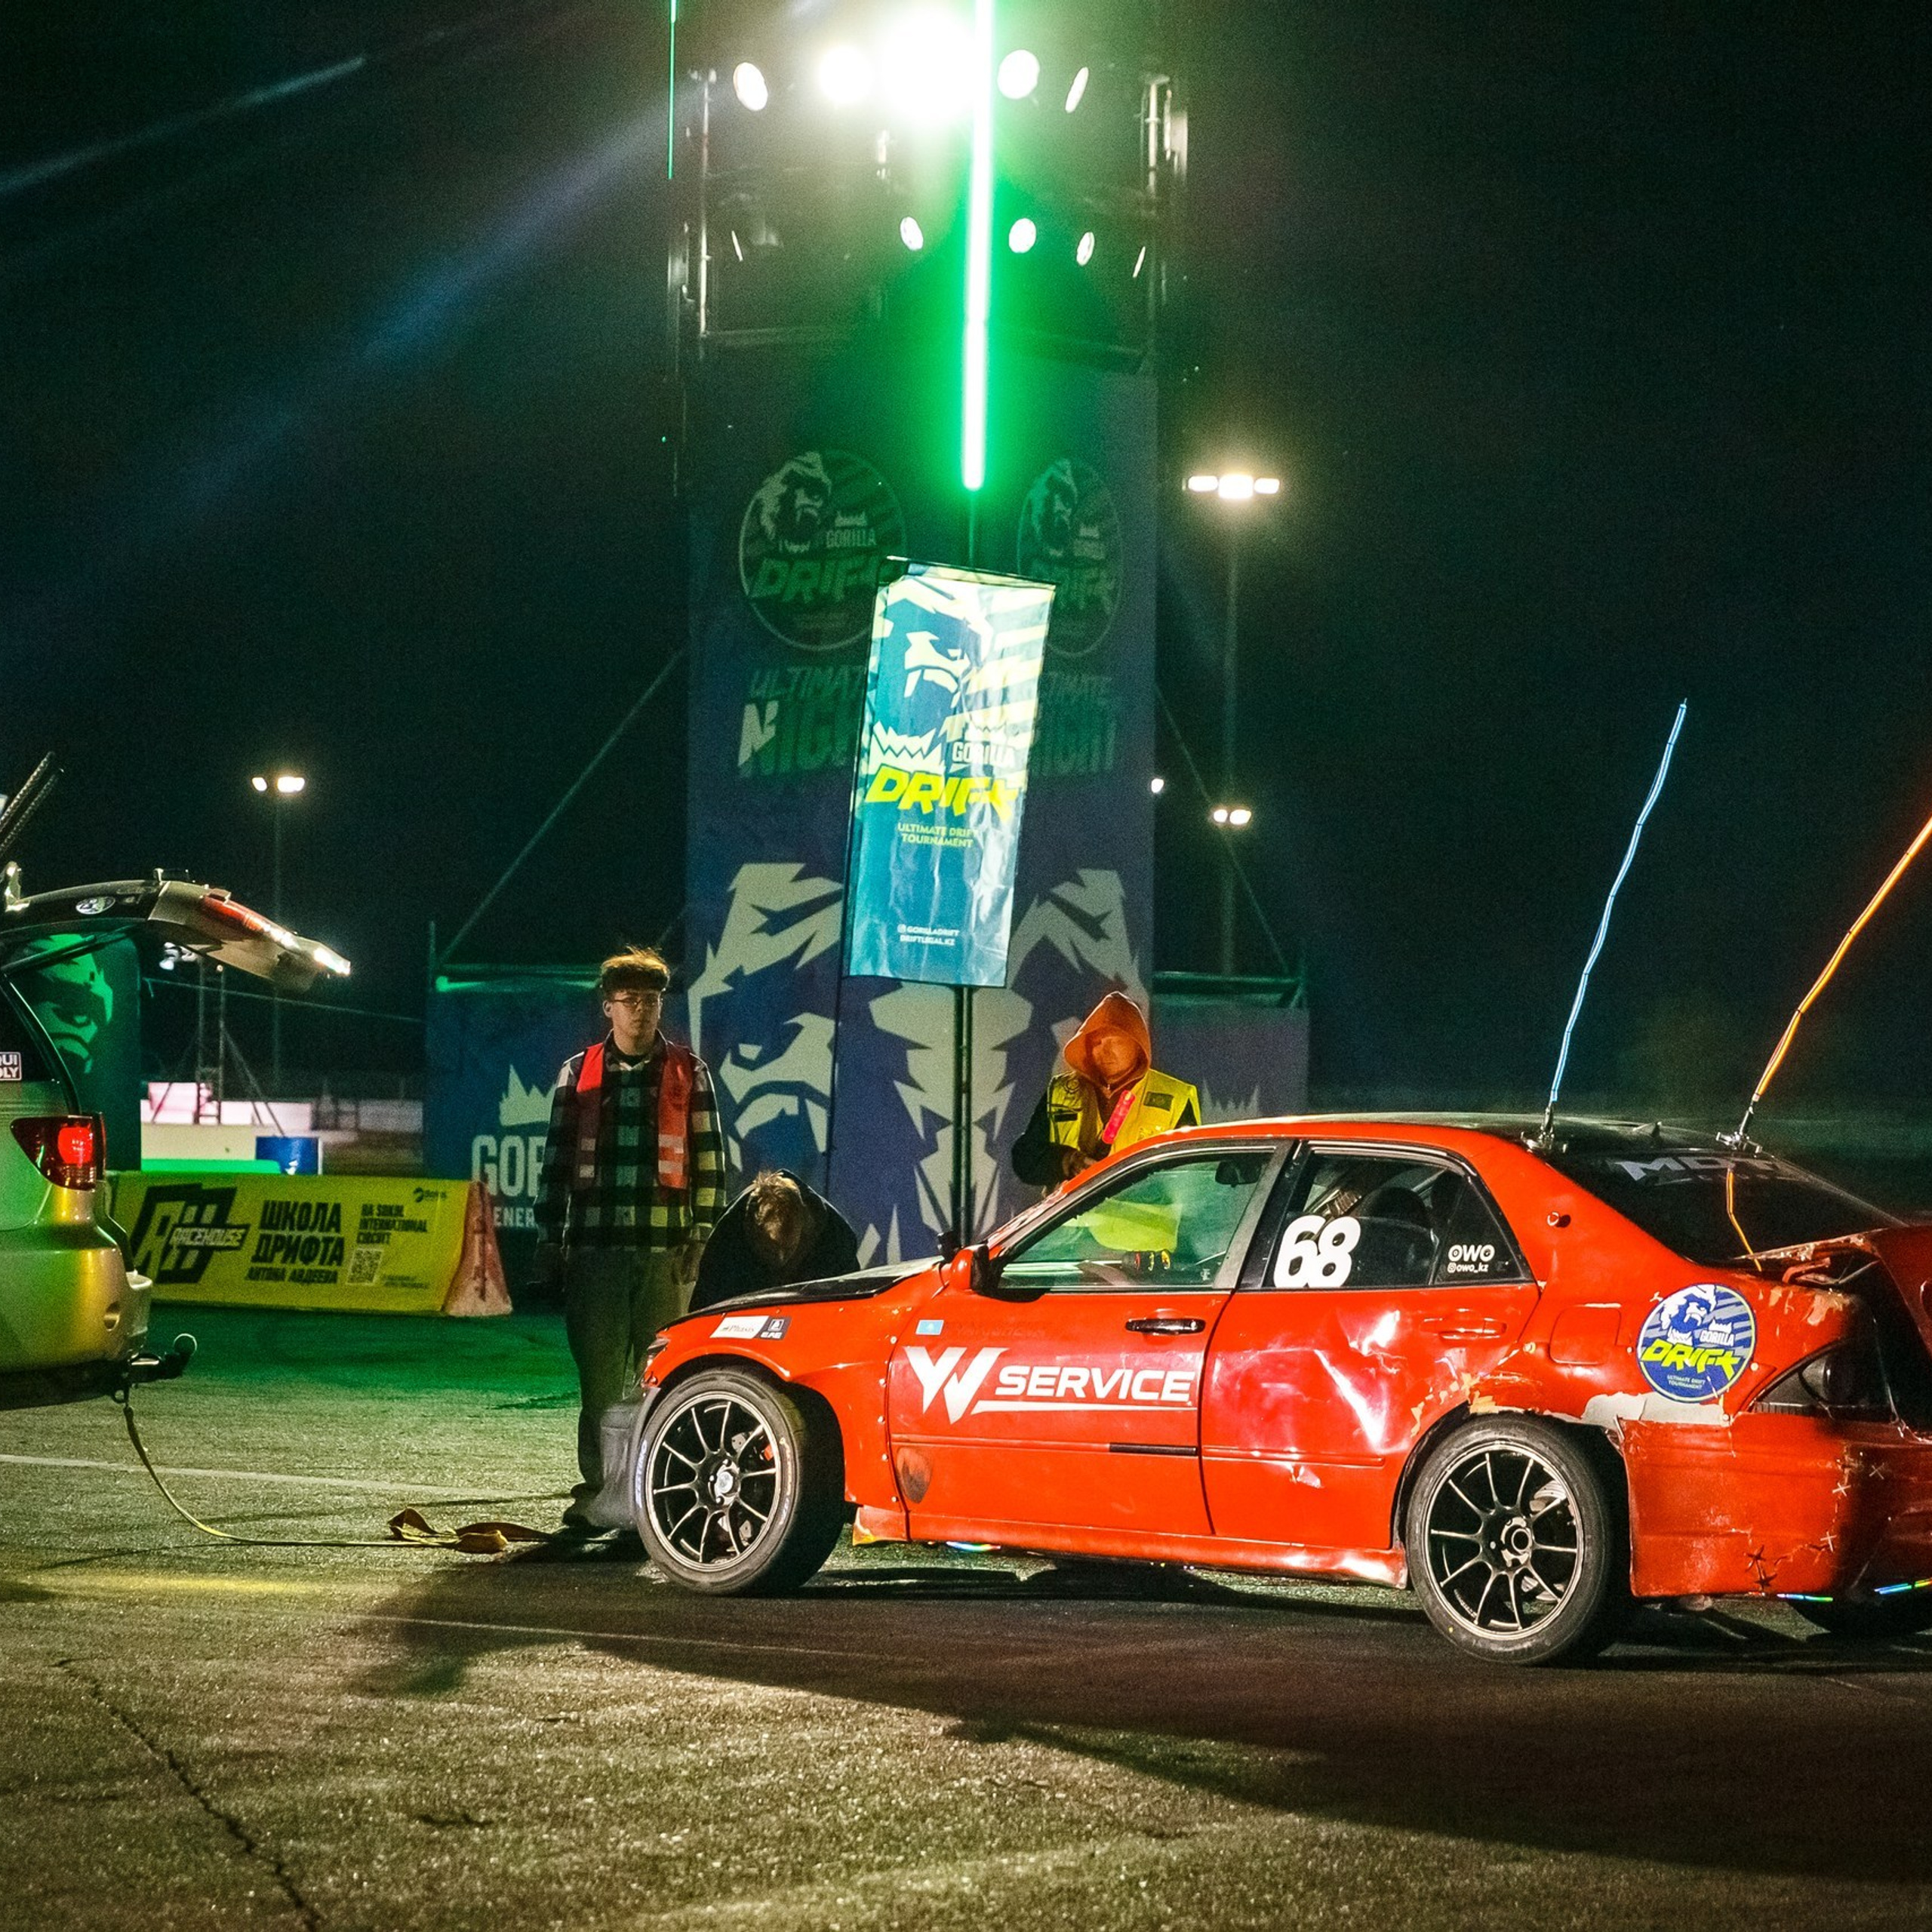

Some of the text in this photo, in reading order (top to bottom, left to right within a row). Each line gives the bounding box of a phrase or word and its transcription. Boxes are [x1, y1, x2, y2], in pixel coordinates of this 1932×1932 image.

[897, 823, 979, 838] ULTIMATE DRIFT
[901, 833, 974, 847] TOURNAMENT
[0, 1054, 17, 1066] UI
[260, 1200, 342, 1233] ШКОЛА
[251, 1234, 345, 1266] ДРИФТА
[1273, 1215, 1361, 1288] 68
[1447, 1244, 1495, 1262] OWO
[1700, 1329, 1734, 1347] GORILLA
[1641, 1338, 1741, 1381] DRIFT
[995, 1366, 1195, 1402] SERVICE
[1666, 1374, 1690, 1383] ULTIMATE
[1668, 1380, 1703, 1390] TOURNAMENT
